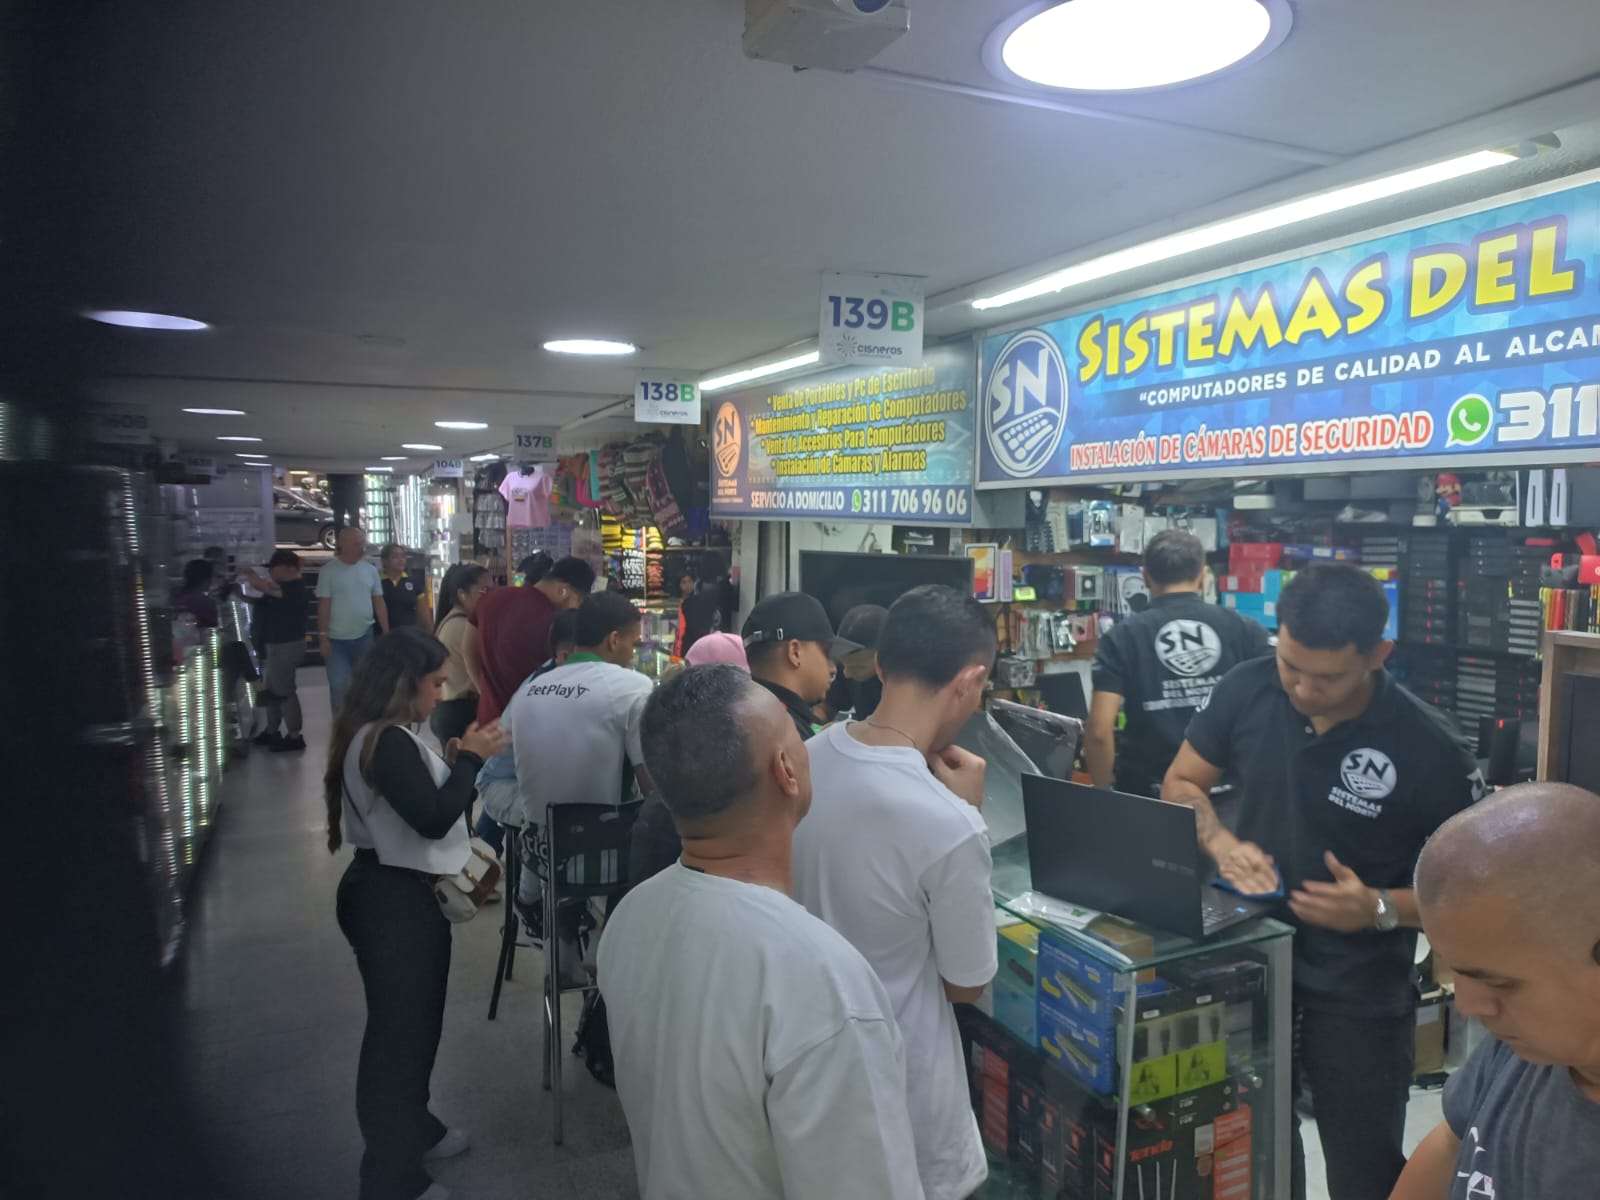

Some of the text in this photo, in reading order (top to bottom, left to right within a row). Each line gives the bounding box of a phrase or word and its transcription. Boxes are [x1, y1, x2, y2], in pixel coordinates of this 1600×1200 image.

[828, 295, 914, 332] 139B
[1078, 224, 1576, 382] SISTEMAS DEL
[857, 343, 902, 355] cisneros
[1296, 365, 1325, 387] DE
[1334, 349, 1441, 381] CALIDAD
[1454, 341, 1491, 366] AL
[640, 382, 696, 402] 138B
[805, 382, 846, 405] Portátiles
[847, 382, 853, 402] y
[854, 377, 866, 398] Pc
[867, 375, 881, 396] de
[881, 363, 935, 393] Escritorio
[990, 347, 1050, 425] SN
[755, 389, 967, 435] Mantenimiento y Reparación de Computadores
[1498, 383, 1600, 442] 311
[516, 434, 552, 449] 137B
[765, 421, 945, 456] Venta de Accesorios Para Computadores
[1071, 411, 1434, 470] INSTALACIÓN DE CÁMARAS DE SEGURIDAD
[776, 450, 927, 476] Instalación de Cámaras y Alarmas
[751, 488, 967, 515] SERVICIO A DOMICILIO 311 706 96 06
[1158, 624, 1205, 656] SN
[1345, 753, 1390, 781] SN
